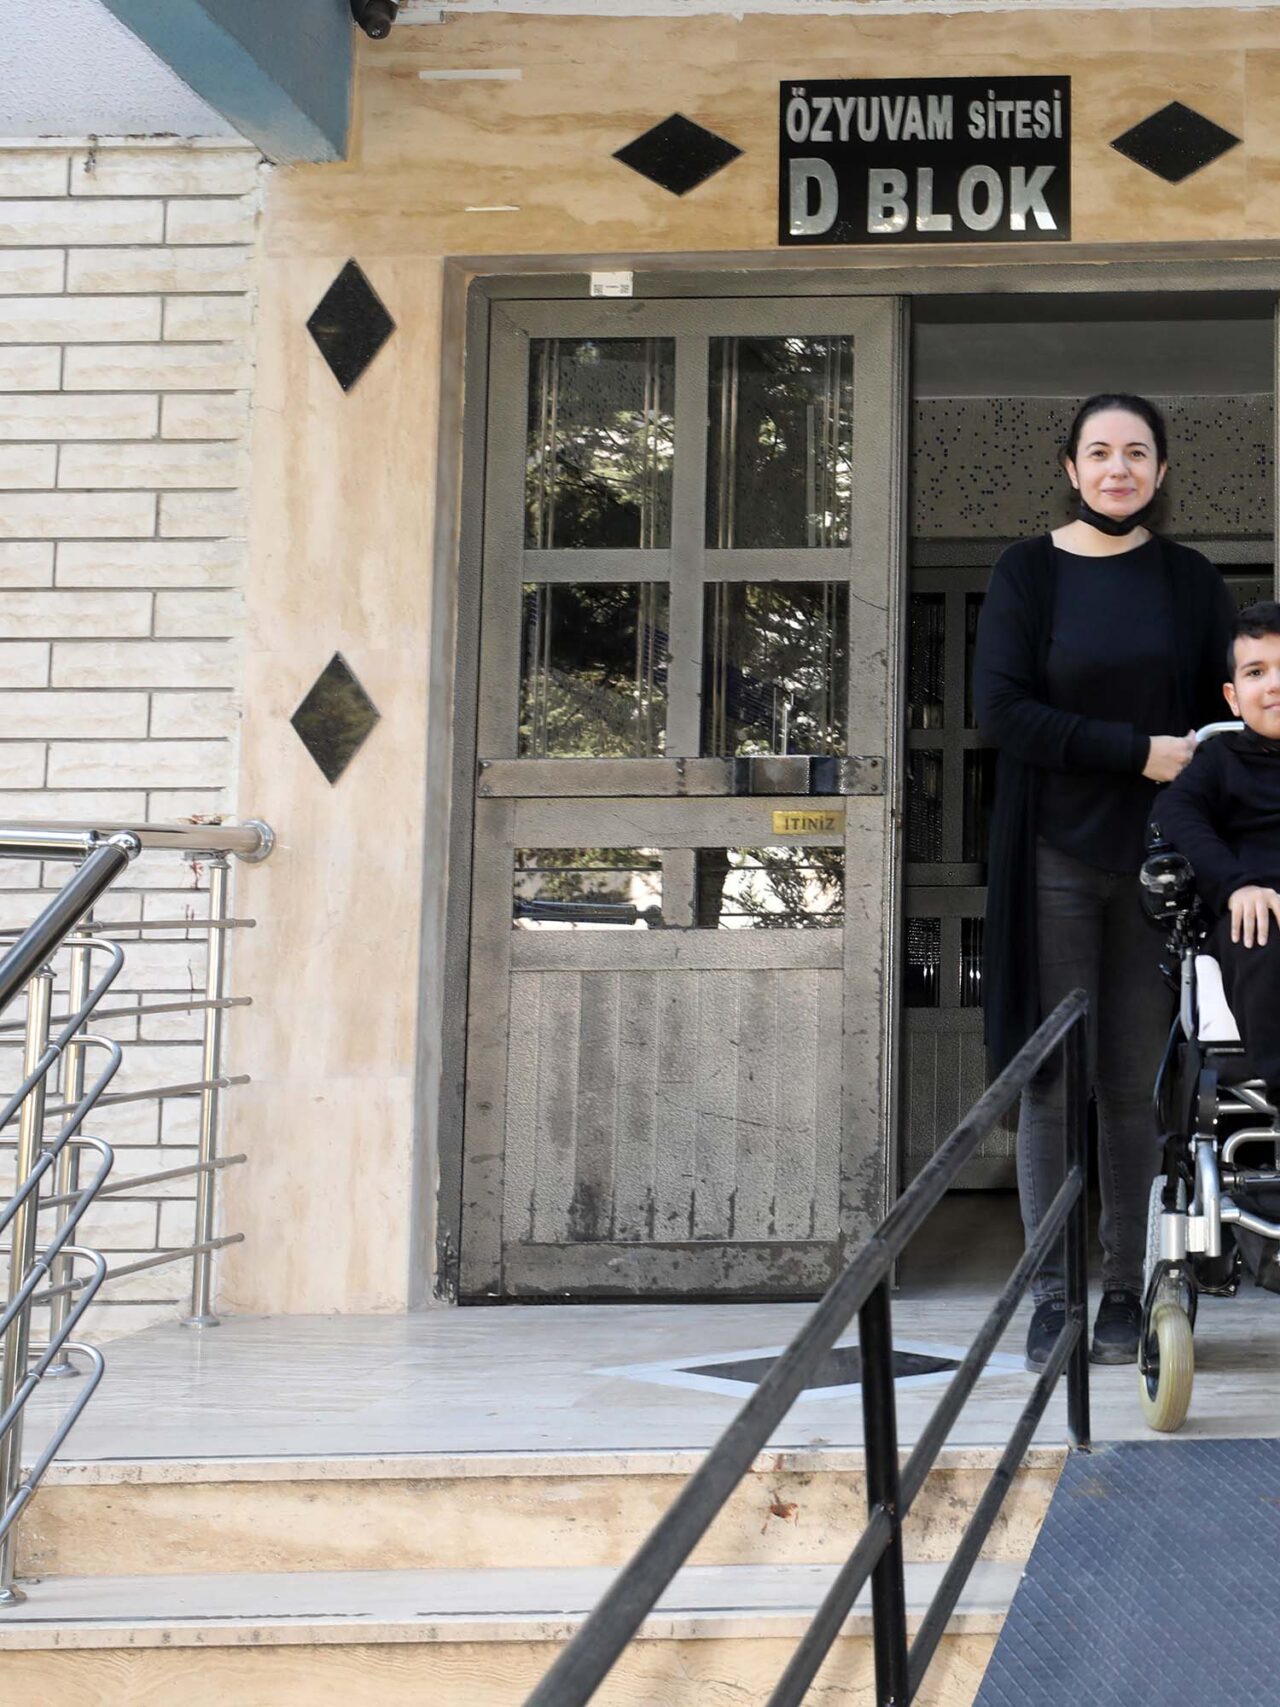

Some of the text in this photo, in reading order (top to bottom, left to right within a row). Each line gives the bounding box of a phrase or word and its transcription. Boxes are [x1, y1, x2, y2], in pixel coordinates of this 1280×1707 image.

[786, 86, 1063, 143] ÖZYUVAM SİTESİ
[789, 157, 1058, 236] D BLOK
